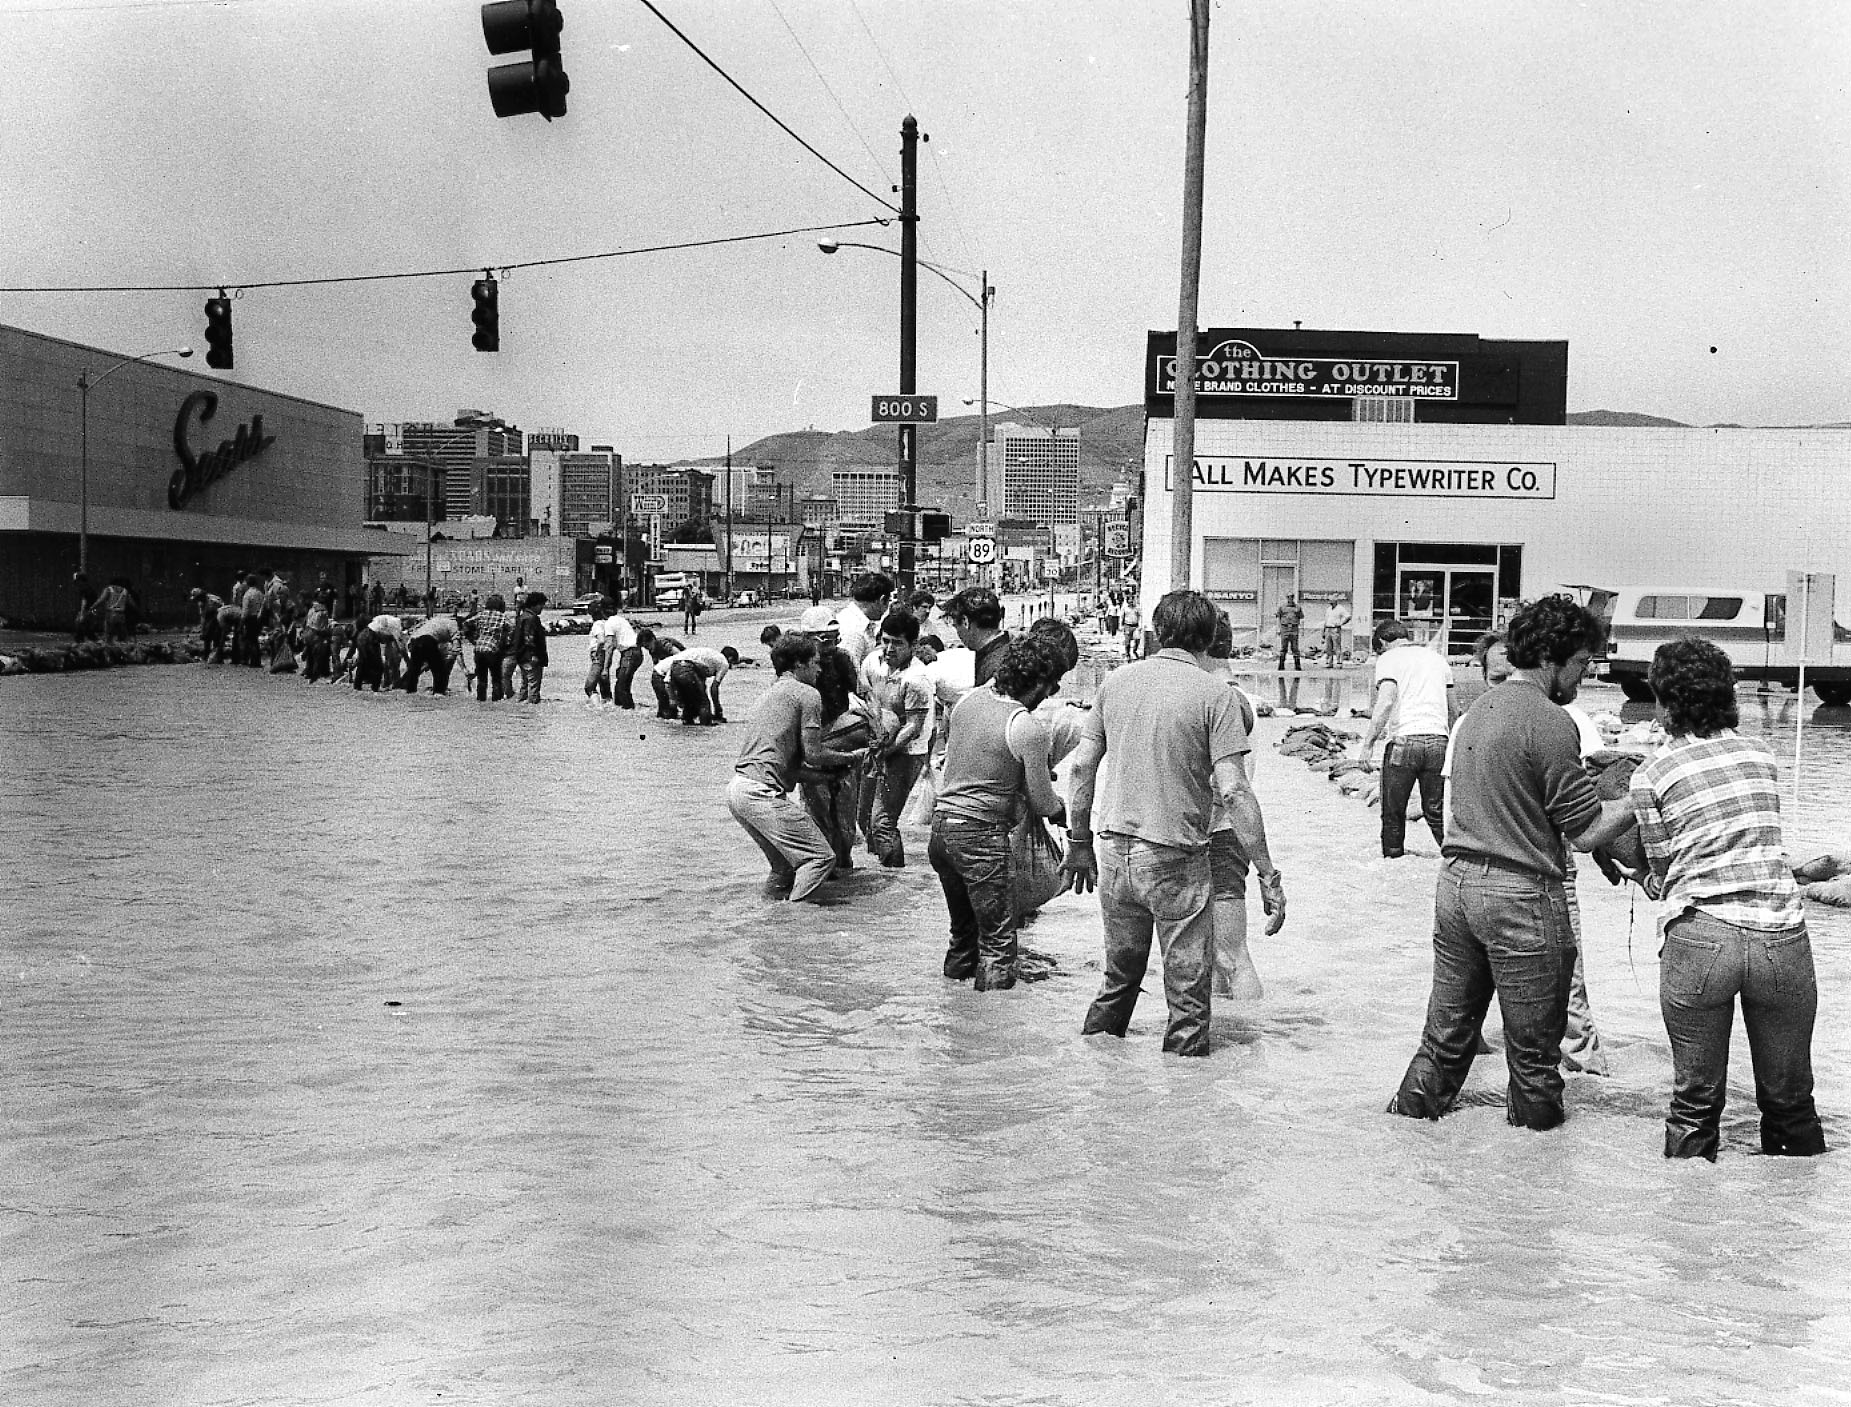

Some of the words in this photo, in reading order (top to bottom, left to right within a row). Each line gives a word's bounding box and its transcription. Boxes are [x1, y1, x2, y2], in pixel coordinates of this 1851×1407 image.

[1223, 344, 1252, 358] the
[1165, 359, 1318, 380] COTHING
[1332, 363, 1448, 383] OUTLET
[1166, 380, 1201, 391] NE
[1204, 380, 1242, 392] BRAND
[1246, 382, 1305, 393] CLOTHES
[1321, 384, 1341, 394] AT
[1344, 384, 1407, 396] DISCOUNT
[1409, 386, 1452, 397] PRICES
[879, 401, 913, 416] 800
[920, 402, 928, 416] S
[1243, 461, 1335, 488] MAKES
[1347, 463, 1495, 490] TYPEWRITER
[970, 525, 994, 533] NORTH
[974, 543, 990, 558] 89
[1213, 591, 1254, 600] SANYO
